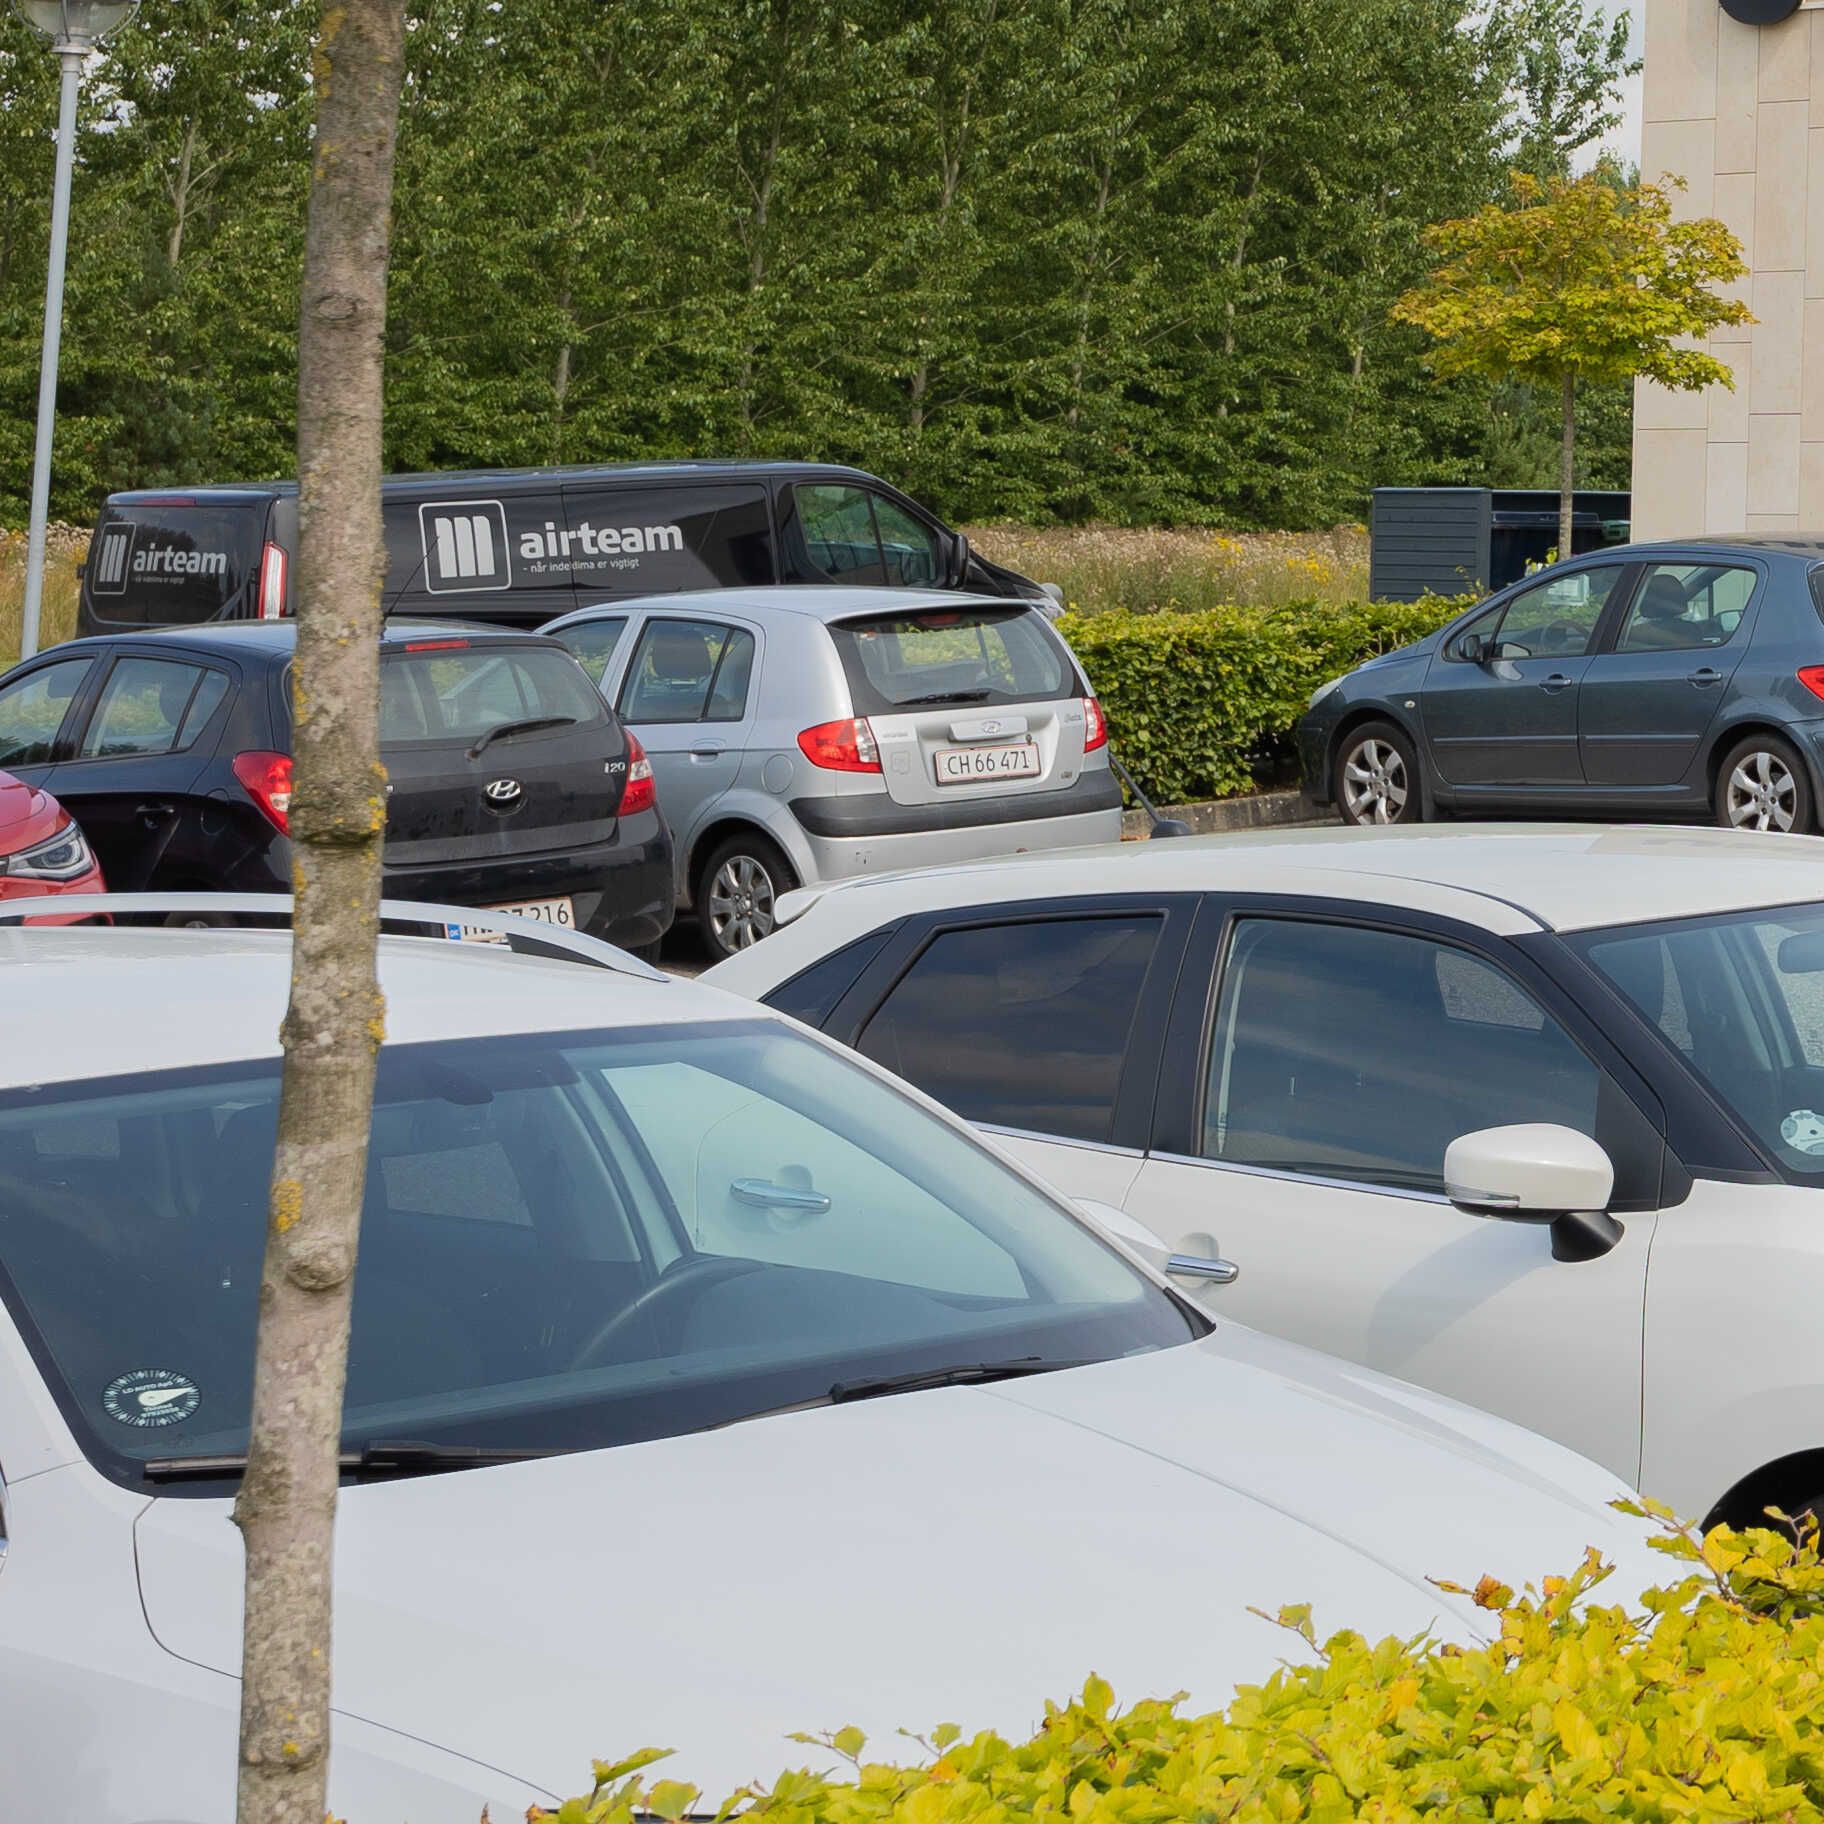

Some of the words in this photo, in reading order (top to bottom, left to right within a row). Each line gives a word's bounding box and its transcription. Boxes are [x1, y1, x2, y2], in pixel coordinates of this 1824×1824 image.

[520, 522, 684, 559] airteam
[133, 542, 227, 574] airteam
[530, 561, 547, 573] når
[610, 558, 640, 569] vigtigt
[947, 755, 970, 775] CH
[975, 753, 996, 772] 66
[1000, 750, 1030, 770] 471
